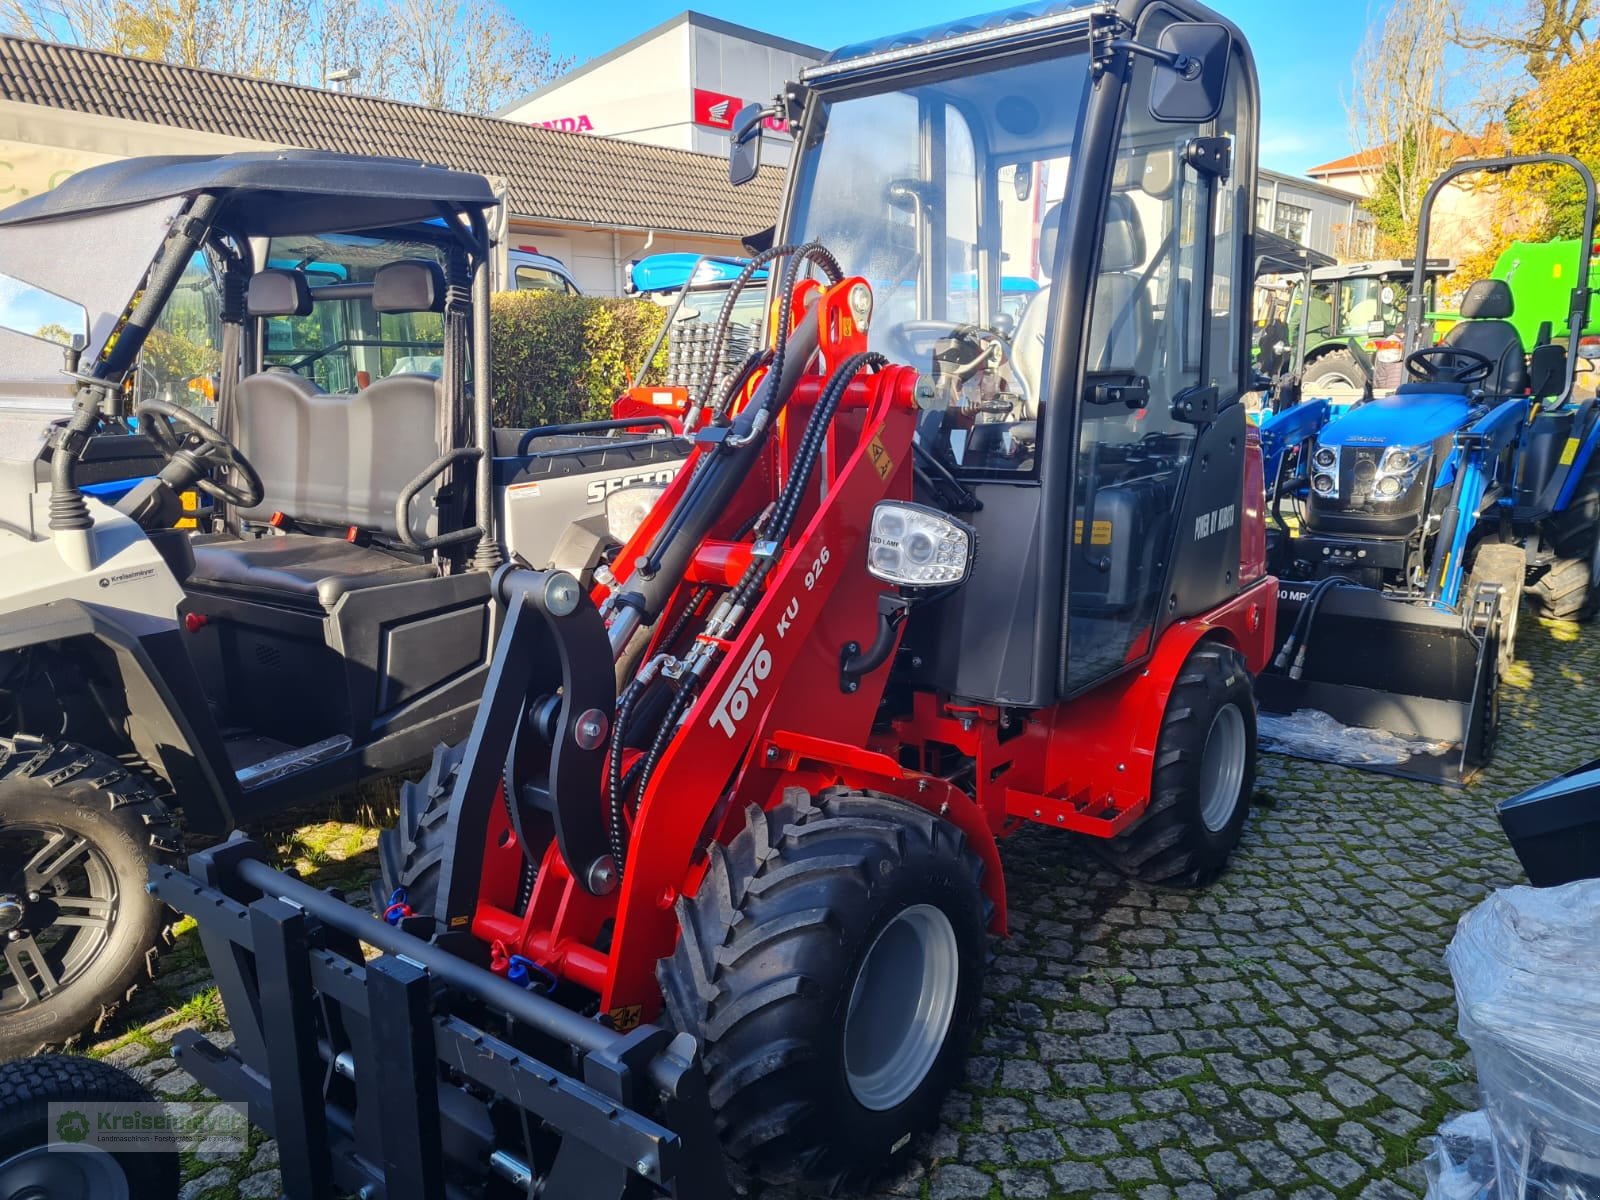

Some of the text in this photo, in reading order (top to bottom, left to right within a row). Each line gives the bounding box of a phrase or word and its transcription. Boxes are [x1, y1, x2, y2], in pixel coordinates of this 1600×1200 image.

[530, 114, 594, 132] NDA
[587, 468, 681, 505] SECTO
[1194, 513, 1210, 541] POWER
[1210, 510, 1218, 535] BY
[870, 536, 900, 548] LED LAMP
[709, 546, 830, 738] TOYO KU 926
